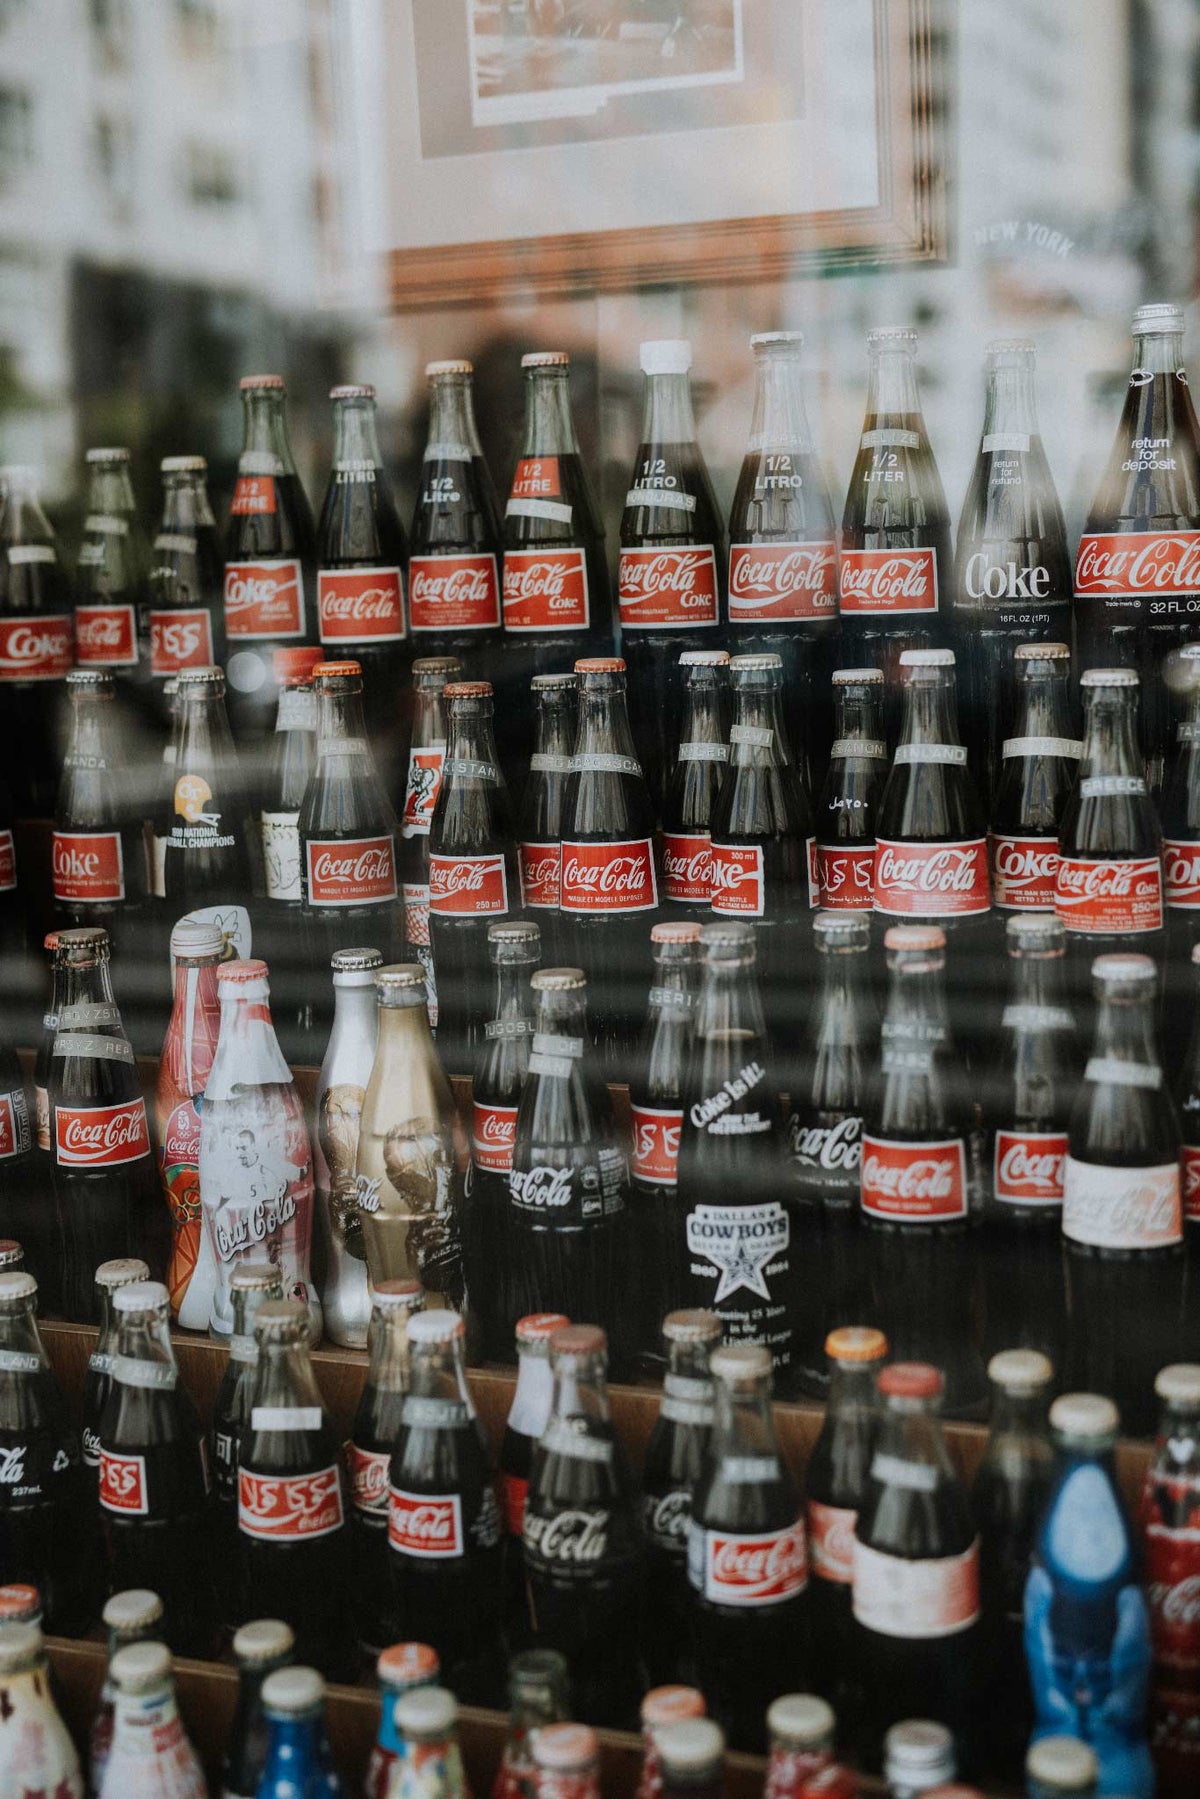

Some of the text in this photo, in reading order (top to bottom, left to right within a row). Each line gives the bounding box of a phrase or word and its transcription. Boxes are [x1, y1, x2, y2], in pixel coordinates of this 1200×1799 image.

[972, 221, 1075, 258] NEW YORK
[1131, 437, 1170, 450] return
[872, 452, 898, 467] 1/2
[1139, 448, 1159, 460] for
[523, 463, 542, 477] 1/2
[643, 459, 666, 475] 1/2
[767, 456, 792, 471] 1/2
[993, 459, 1019, 468] return
[1121, 459, 1177, 472] deposit
[863, 471, 904, 482] LITER
[1000, 468, 1013, 477] for
[431, 477, 454, 490] 1/2
[513, 478, 552, 493] LITRE
[634, 476, 677, 489] LITRO
[755, 474, 802, 490] LITRO
[423, 490, 461, 503] Litre
[733, 550, 825, 593] Coca-Cola
[1075, 538, 1200, 590] Coca-Cola
[504, 562, 567, 597] oca-Cola
[620, 553, 698, 592] Coca-Cola
[839, 557, 930, 599] Coca-Cola
[965, 553, 1050, 599] Coke
[226, 571, 279, 604] Coke
[412, 568, 489, 603] Coca-Cola
[322, 588, 396, 621] Coca-Cola
[549, 594, 579, 609] Coke
[680, 591, 712, 608] Coke
[1150, 602, 1166, 614] 32
[1187, 600, 1200, 612] OZ
[64, 755, 107, 769] WANDA
[443, 761, 498, 778] KISTAN
[1081, 779, 1145, 794] GREECE
[183, 826, 220, 838] NATIONAL
[188, 835, 235, 849] CHAMPIONS
[53, 840, 100, 877] Coke
[314, 848, 392, 883] Coca-Cola
[995, 842, 1061, 877] Coke
[563, 856, 647, 893] Coca-Cola
[878, 848, 979, 892] Coca-Cola
[1057, 863, 1135, 896] Coca-Cola
[475, 901, 490, 910] 250
[66, 1109, 142, 1150] Coca-Cola
[863, 1154, 954, 1199] Coca-Cola
[249, 1184, 257, 1198] 5
[510, 1166, 575, 1207] ca-Cola
[215, 1178, 297, 1263] Coca-Cola
[690, 1217, 787, 1240] COWBOYS
